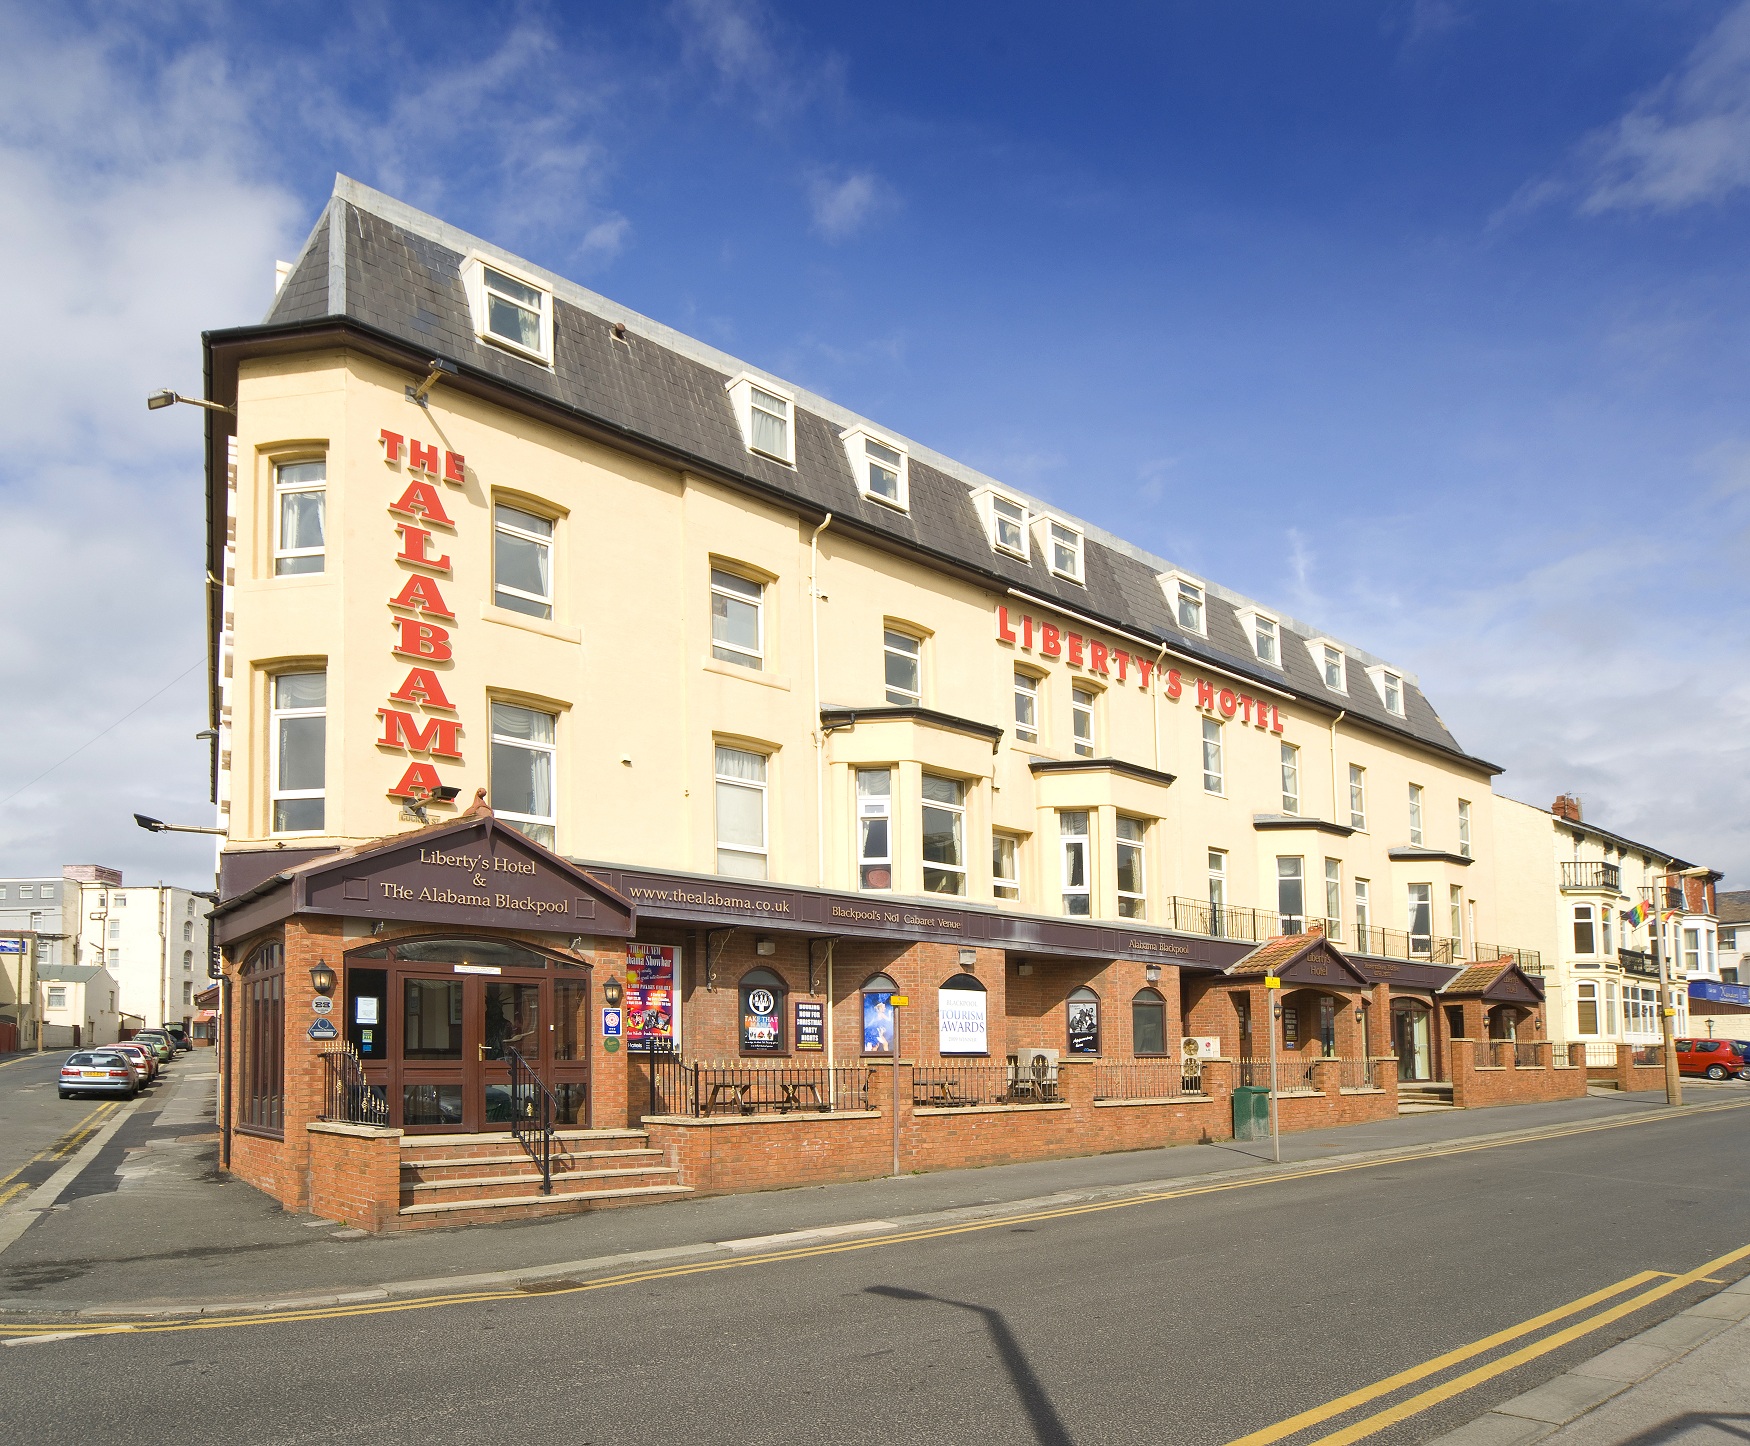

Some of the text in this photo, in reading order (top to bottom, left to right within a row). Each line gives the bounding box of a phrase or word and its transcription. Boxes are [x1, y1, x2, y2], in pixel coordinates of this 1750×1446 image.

[378, 428, 466, 485] THE
[376, 479, 464, 803] ALABAMA
[995, 605, 1284, 734] LIBERTY'S HOTEL
[420, 849, 537, 875] Liberty's Hotel
[472, 873, 487, 887] &
[380, 882, 569, 916] The Alabama Blackpool
[629, 887, 790, 913] www.thealabama.co.uk
[832, 906, 881, 921] Blackpool's
[904, 914, 935, 926] Cabaret
[937, 918, 961, 929] Venue
[629, 945, 639, 953] THE
[641, 946, 650, 954] ALL
[1128, 939, 1189, 955] Alabama Blackpool
[1306, 952, 1331, 965] Liberty's
[1309, 965, 1328, 976] Hotel
[946, 999, 978, 1007] BLACKPOOL
[940, 1009, 984, 1020] TOURISM
[941, 1020, 985, 1033] AWARDS
